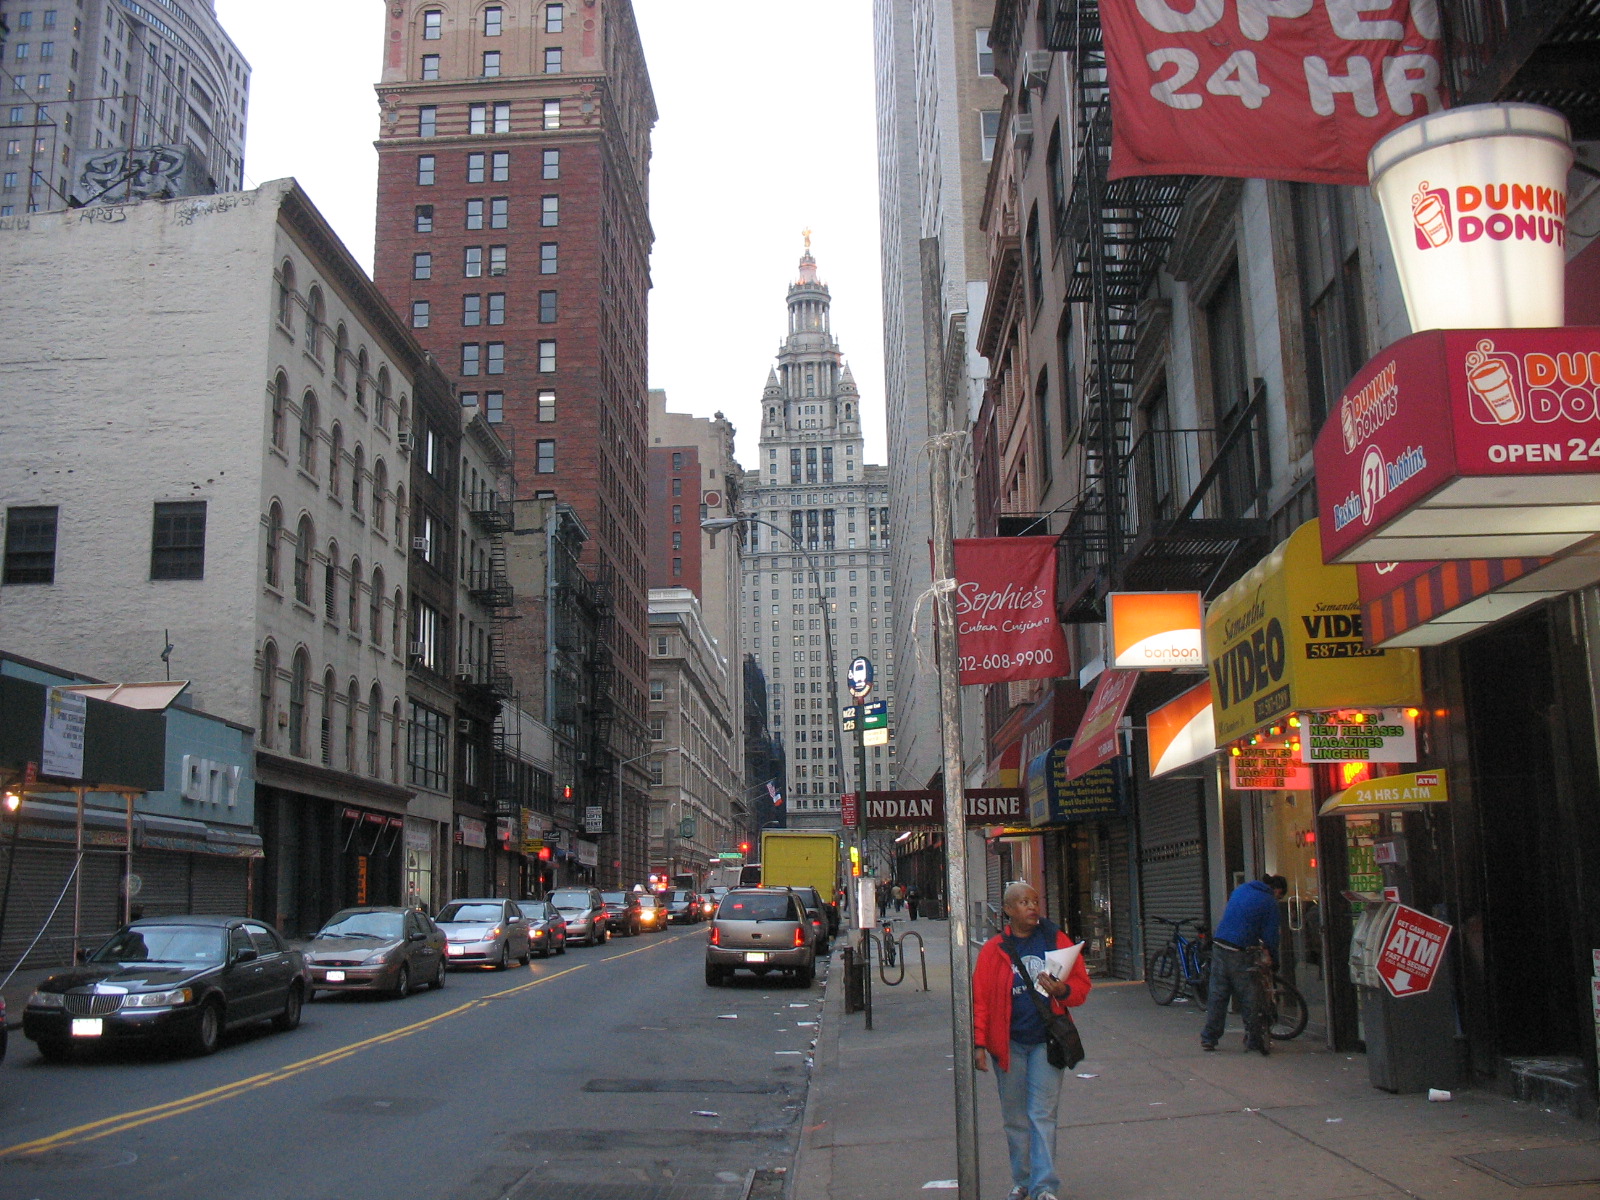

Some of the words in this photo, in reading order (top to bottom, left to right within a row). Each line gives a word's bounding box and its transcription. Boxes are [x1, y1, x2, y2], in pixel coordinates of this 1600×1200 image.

[1146, 47, 1270, 110] 24
[1458, 213, 1566, 250] DONUT
[1528, 386, 1600, 423] DO
[1488, 443, 1561, 463] OPEN
[1334, 491, 1362, 532] Baskin
[1386, 445, 1427, 493] Robbins
[956, 581, 1047, 619] Sophie's
[959, 620, 998, 635] Cuban
[1002, 617, 1044, 634] Cuisine
[958, 648, 1054, 672] 212-608-9900
[1144, 644, 1199, 658] bonbon
[1213, 617, 1285, 711] VIDEO
[1309, 726, 1338, 736] NEW
[1341, 726, 1404, 737] RELEASES
[1310, 737, 1384, 748] MAGAZINES
[1235, 759, 1259, 768] NEW
[1311, 749, 1370, 760] LINGERIE
[1235, 768, 1297, 777] MAGAZINES
[1417, 777, 1438, 785] ATM
[1236, 778, 1285, 787] LINGERIE
[1356, 790, 1372, 802] 24
[1375, 788, 1400, 801] HRS
[1402, 786, 1431, 800] ATM
[866, 799, 934, 817] INDIAN
[943, 797, 1020, 817] ISINE
[1409, 924, 1426, 936] CASH
[1388, 928, 1440, 967] ATM
